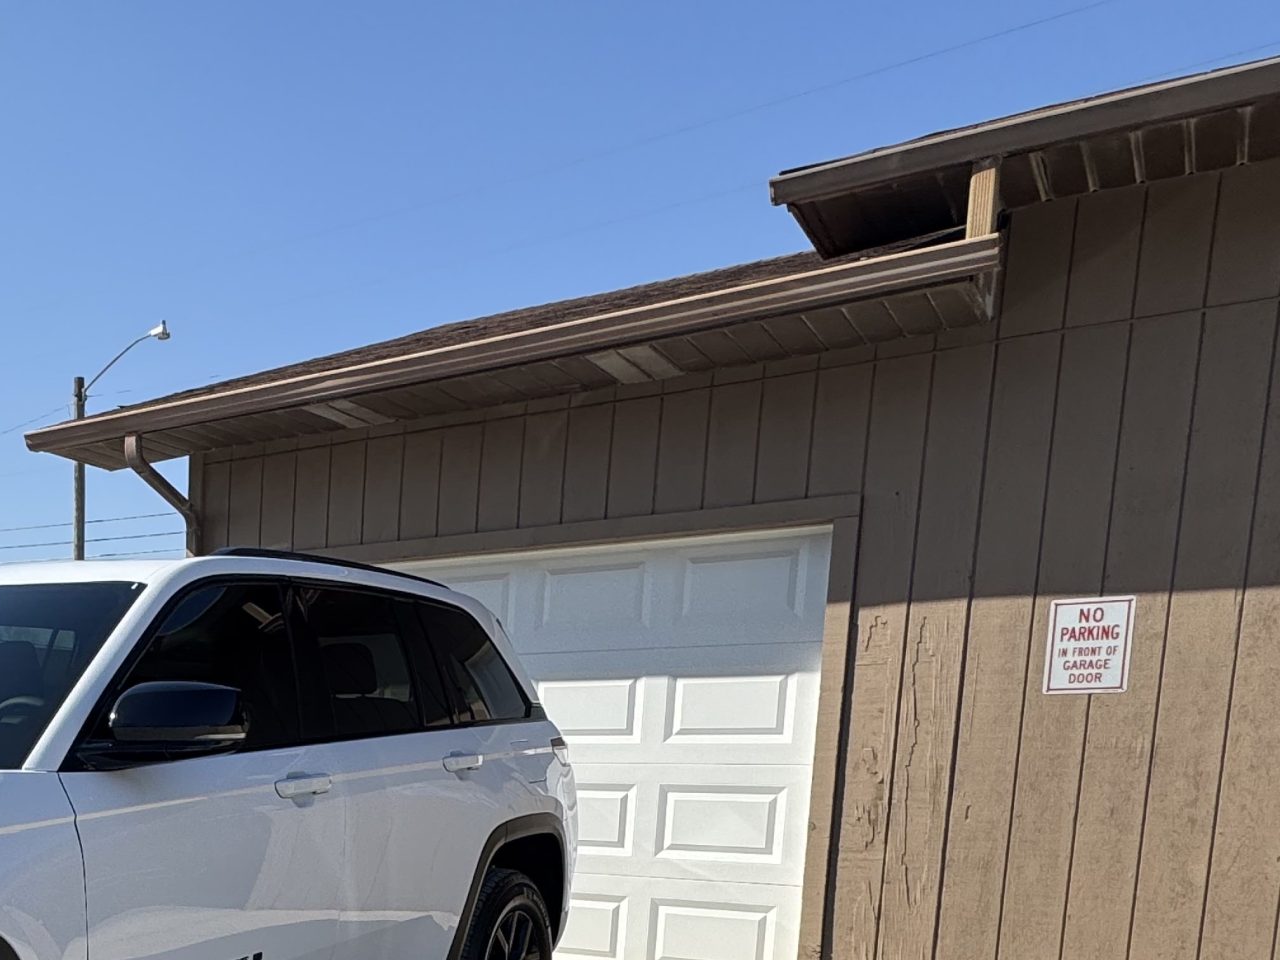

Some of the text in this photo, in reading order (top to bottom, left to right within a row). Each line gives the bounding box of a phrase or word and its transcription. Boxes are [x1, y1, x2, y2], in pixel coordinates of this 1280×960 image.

[1078, 607, 1105, 623] NO
[1059, 624, 1120, 642] PARKING
[1057, 645, 1119, 658] IN FRONT OF
[1062, 659, 1112, 671] GARAGE
[1068, 672, 1103, 684] DOOR
